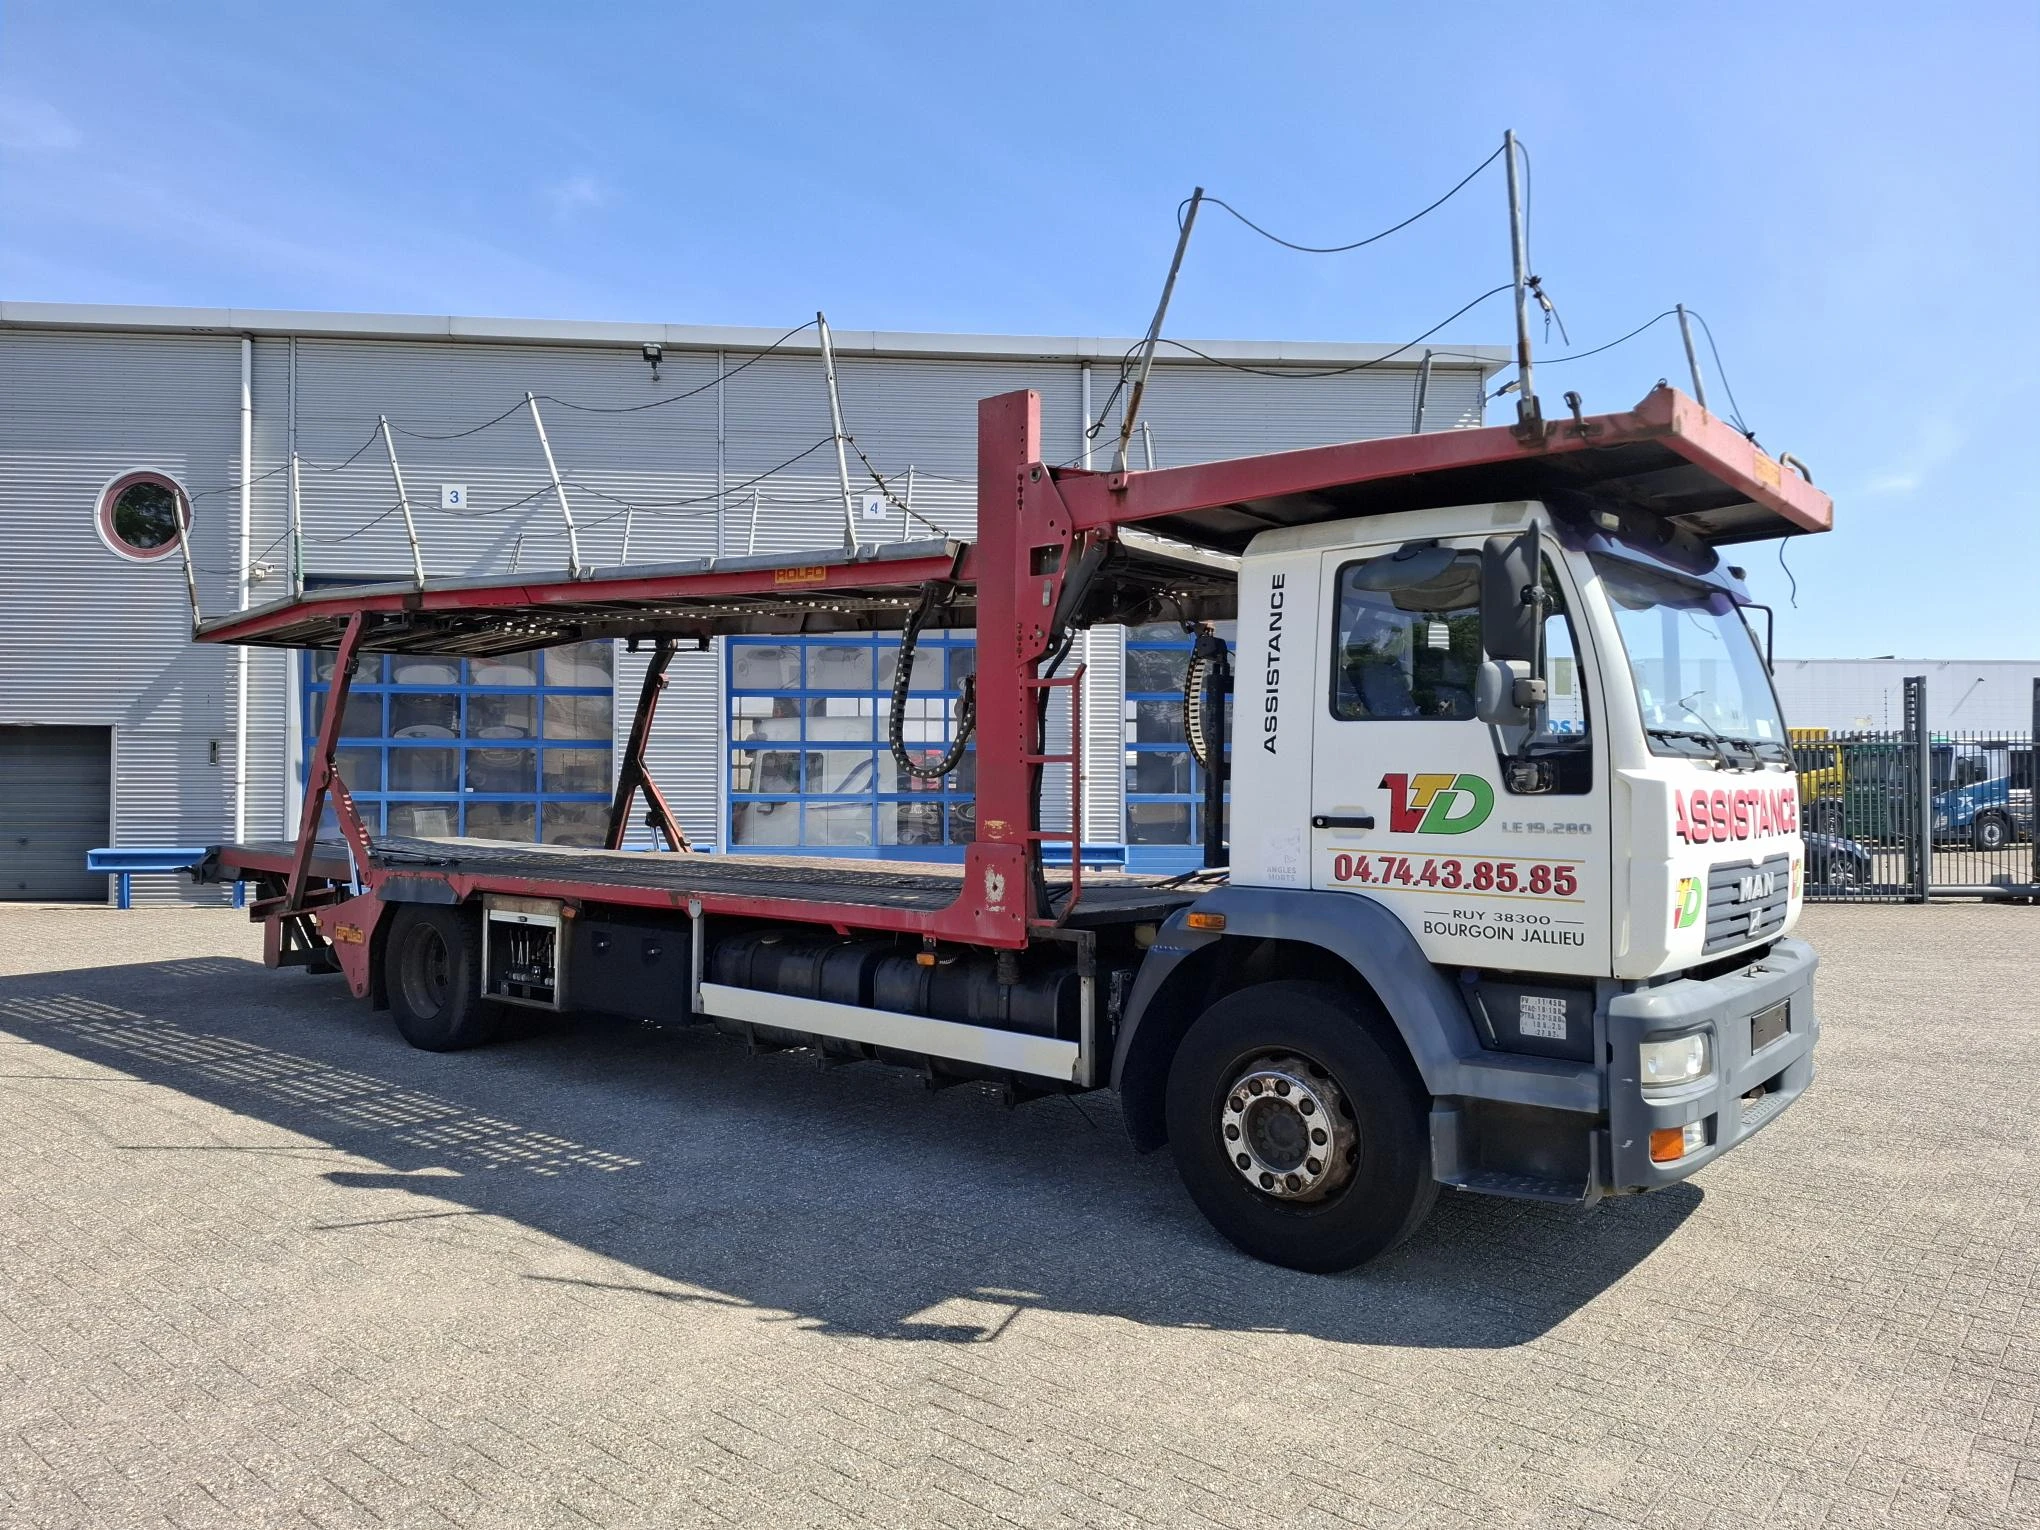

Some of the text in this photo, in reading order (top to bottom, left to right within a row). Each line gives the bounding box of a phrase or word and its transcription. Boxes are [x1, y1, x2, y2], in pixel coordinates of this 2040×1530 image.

[449, 490, 459, 504] 3
[870, 501, 878, 514] 4
[776, 566, 825, 581] ROLFO
[1263, 573, 1285, 755] ASSISTANCE
[1675, 788, 1797, 845] ASSISTANCE
[1334, 853, 1578, 896] 04.74.43.85.85
[1739, 871, 1775, 903] MAN
[1452, 909, 1551, 925] RUY 38300
[1423, 920, 1585, 947] BOURGOIN JALLIEU
